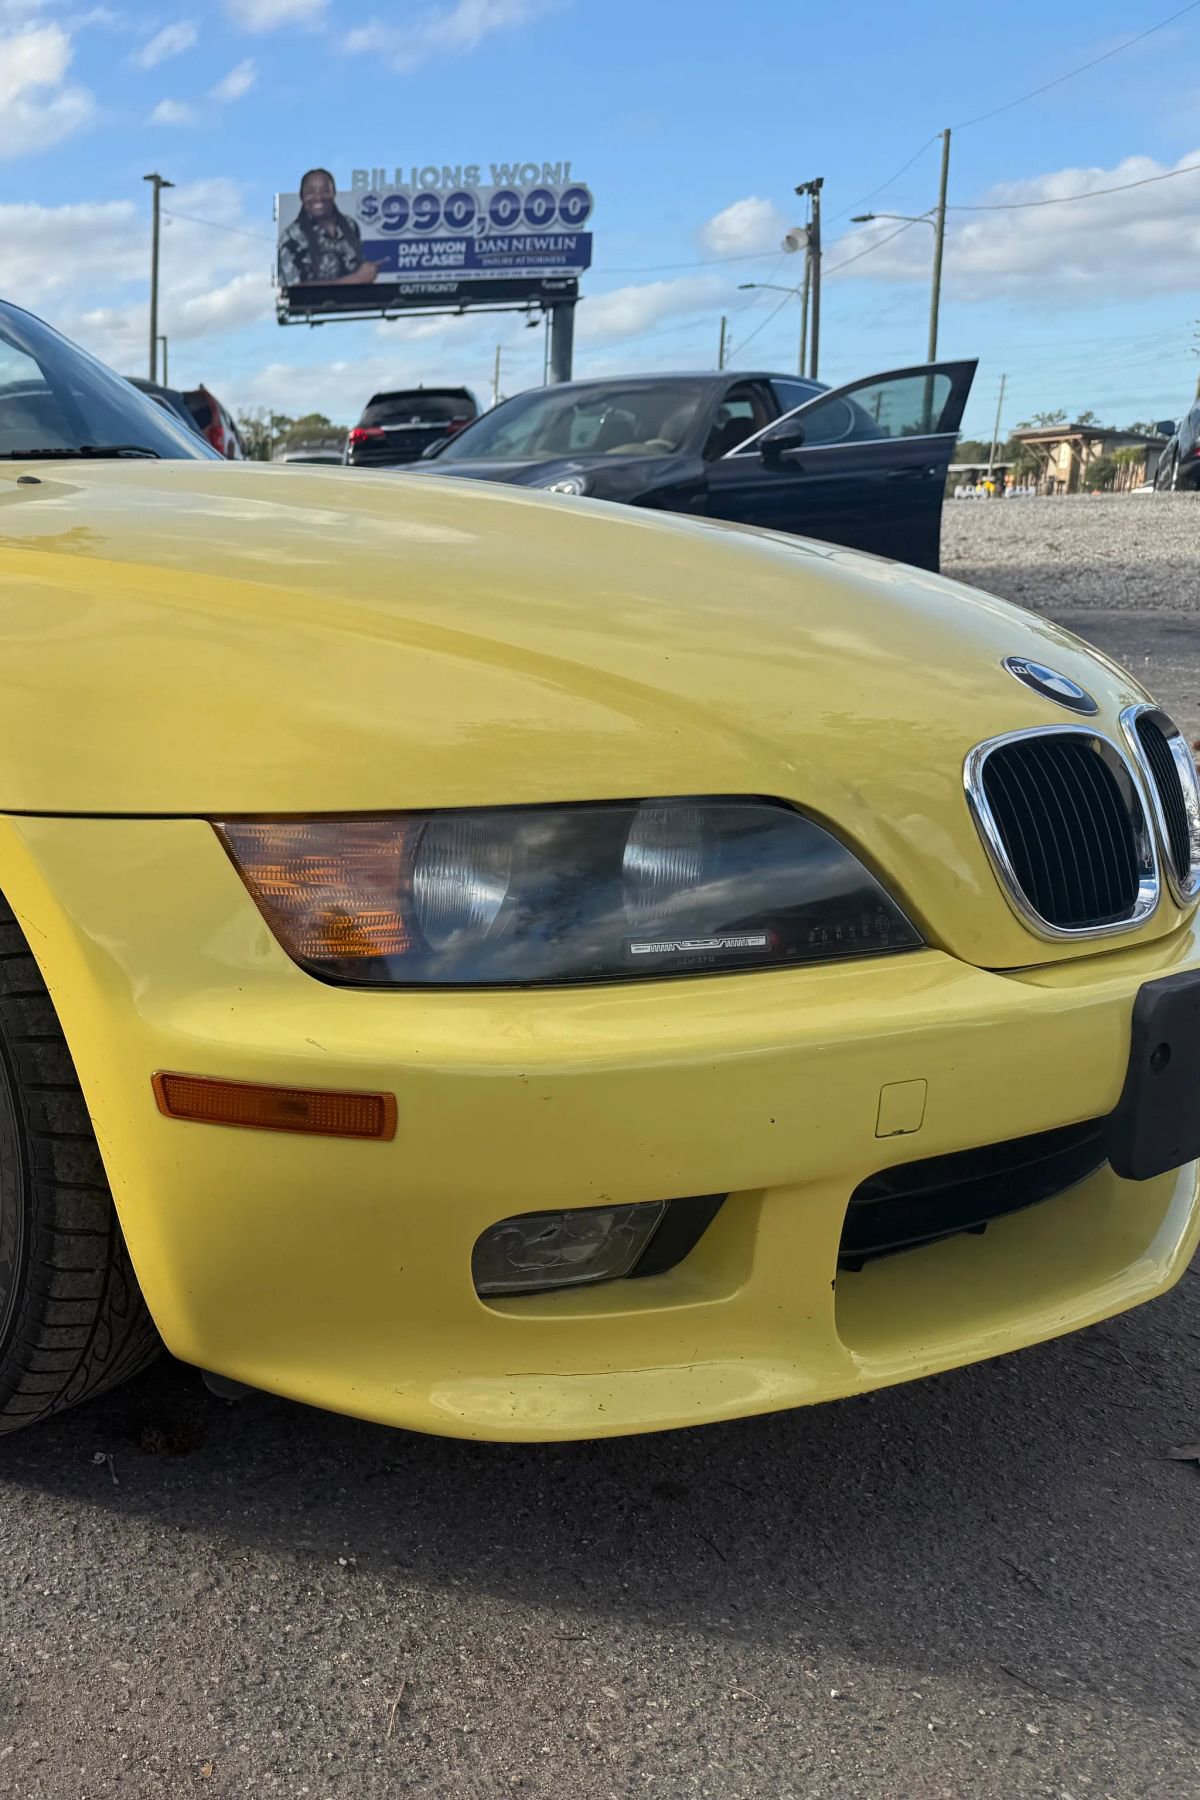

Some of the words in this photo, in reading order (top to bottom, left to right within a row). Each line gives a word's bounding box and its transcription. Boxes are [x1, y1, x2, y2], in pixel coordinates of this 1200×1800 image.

[352, 165, 481, 192] BILLIONS
[490, 160, 572, 187] WON!
[360, 187, 591, 236] $990,000
[398, 242, 429, 255] DAN
[431, 241, 467, 254] WON
[475, 238, 509, 253] DAN
[511, 236, 577, 251] NEWLIN
[398, 254, 419, 267] MY
